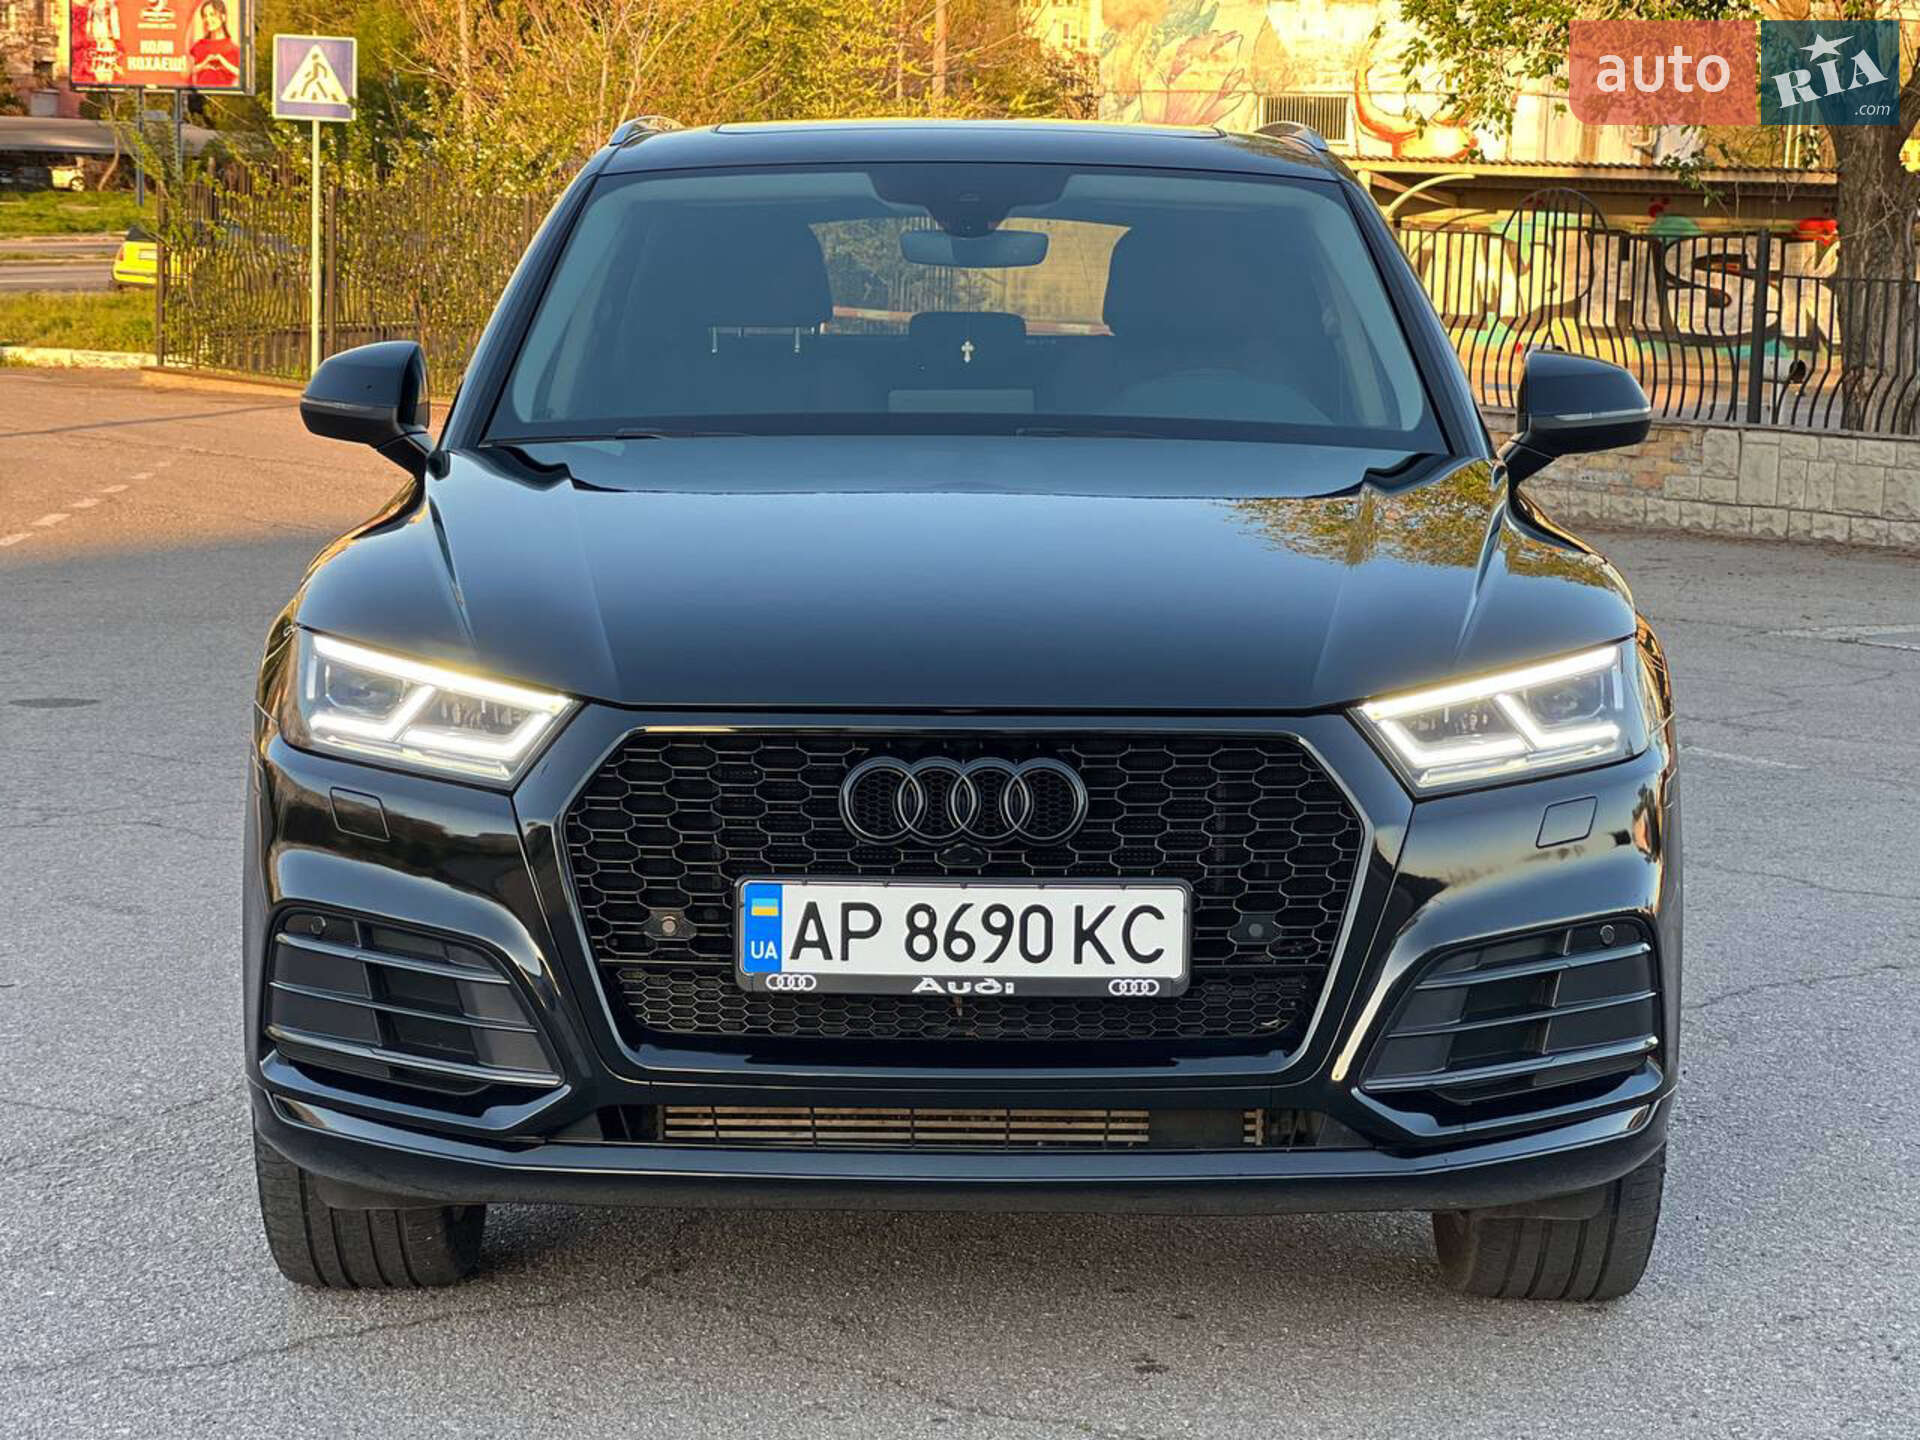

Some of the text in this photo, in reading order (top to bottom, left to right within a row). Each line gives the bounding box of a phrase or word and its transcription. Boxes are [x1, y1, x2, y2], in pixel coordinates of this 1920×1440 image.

[789, 901, 1166, 965] AP 8690 KC
[750, 940, 778, 961] UA
[911, 976, 1015, 995] Audi
